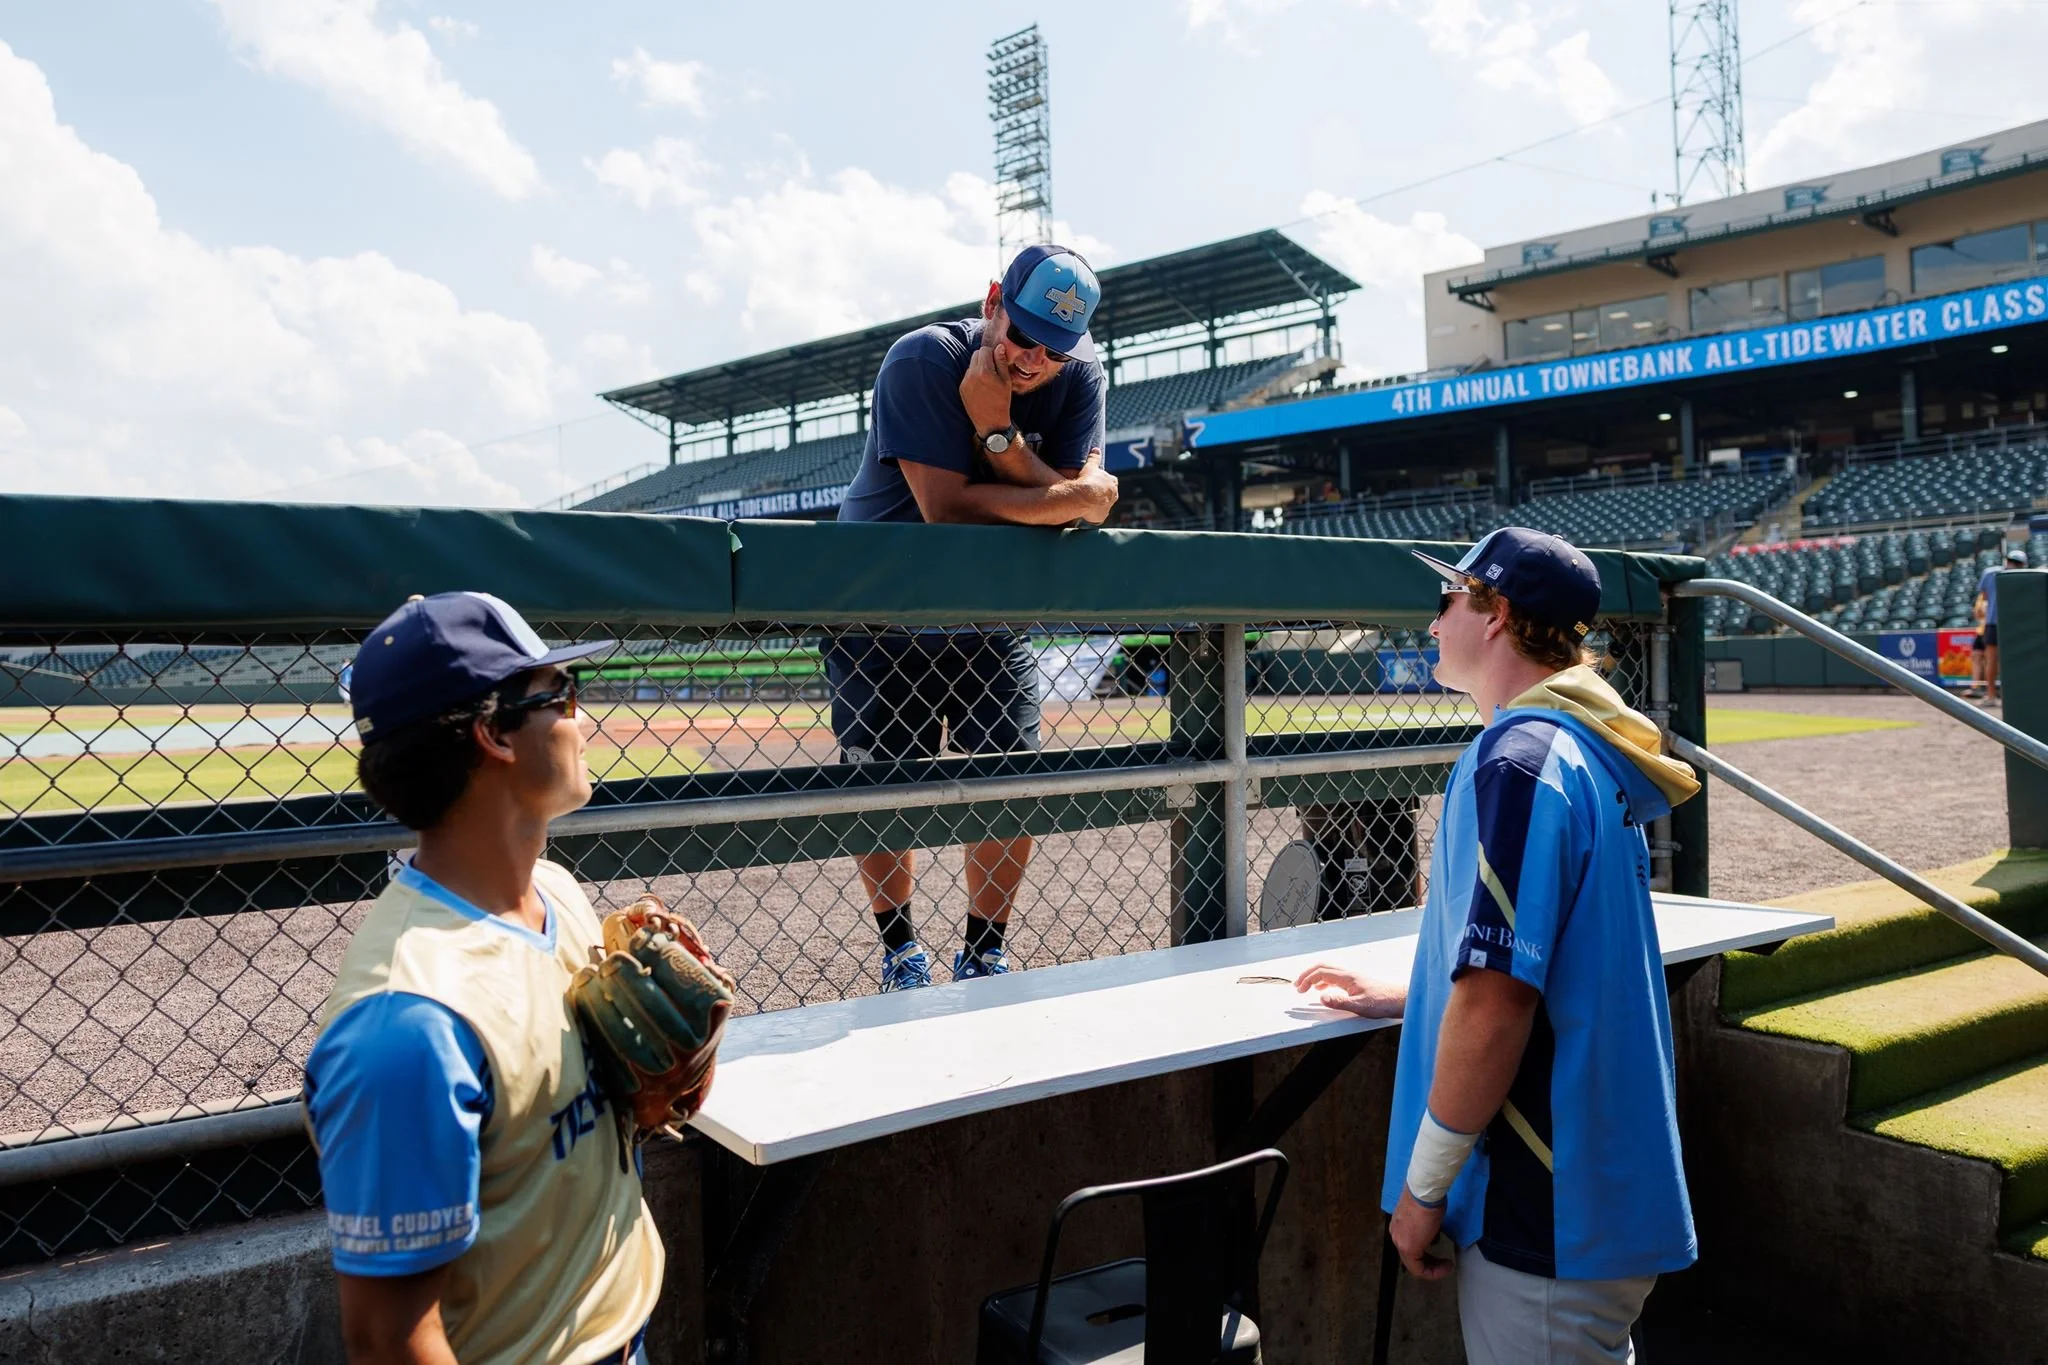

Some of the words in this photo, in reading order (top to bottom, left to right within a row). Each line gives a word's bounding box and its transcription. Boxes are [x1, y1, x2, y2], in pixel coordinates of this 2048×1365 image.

[1391, 386, 1432, 413] 4TH
[1441, 379, 1530, 408] ANNUAL
[1538, 346, 1694, 394] TOWNEBANK
[1705, 308, 1928, 369] ALL-TIDEWATER
[717, 493, 797, 520] ALL-TIDEWATER
